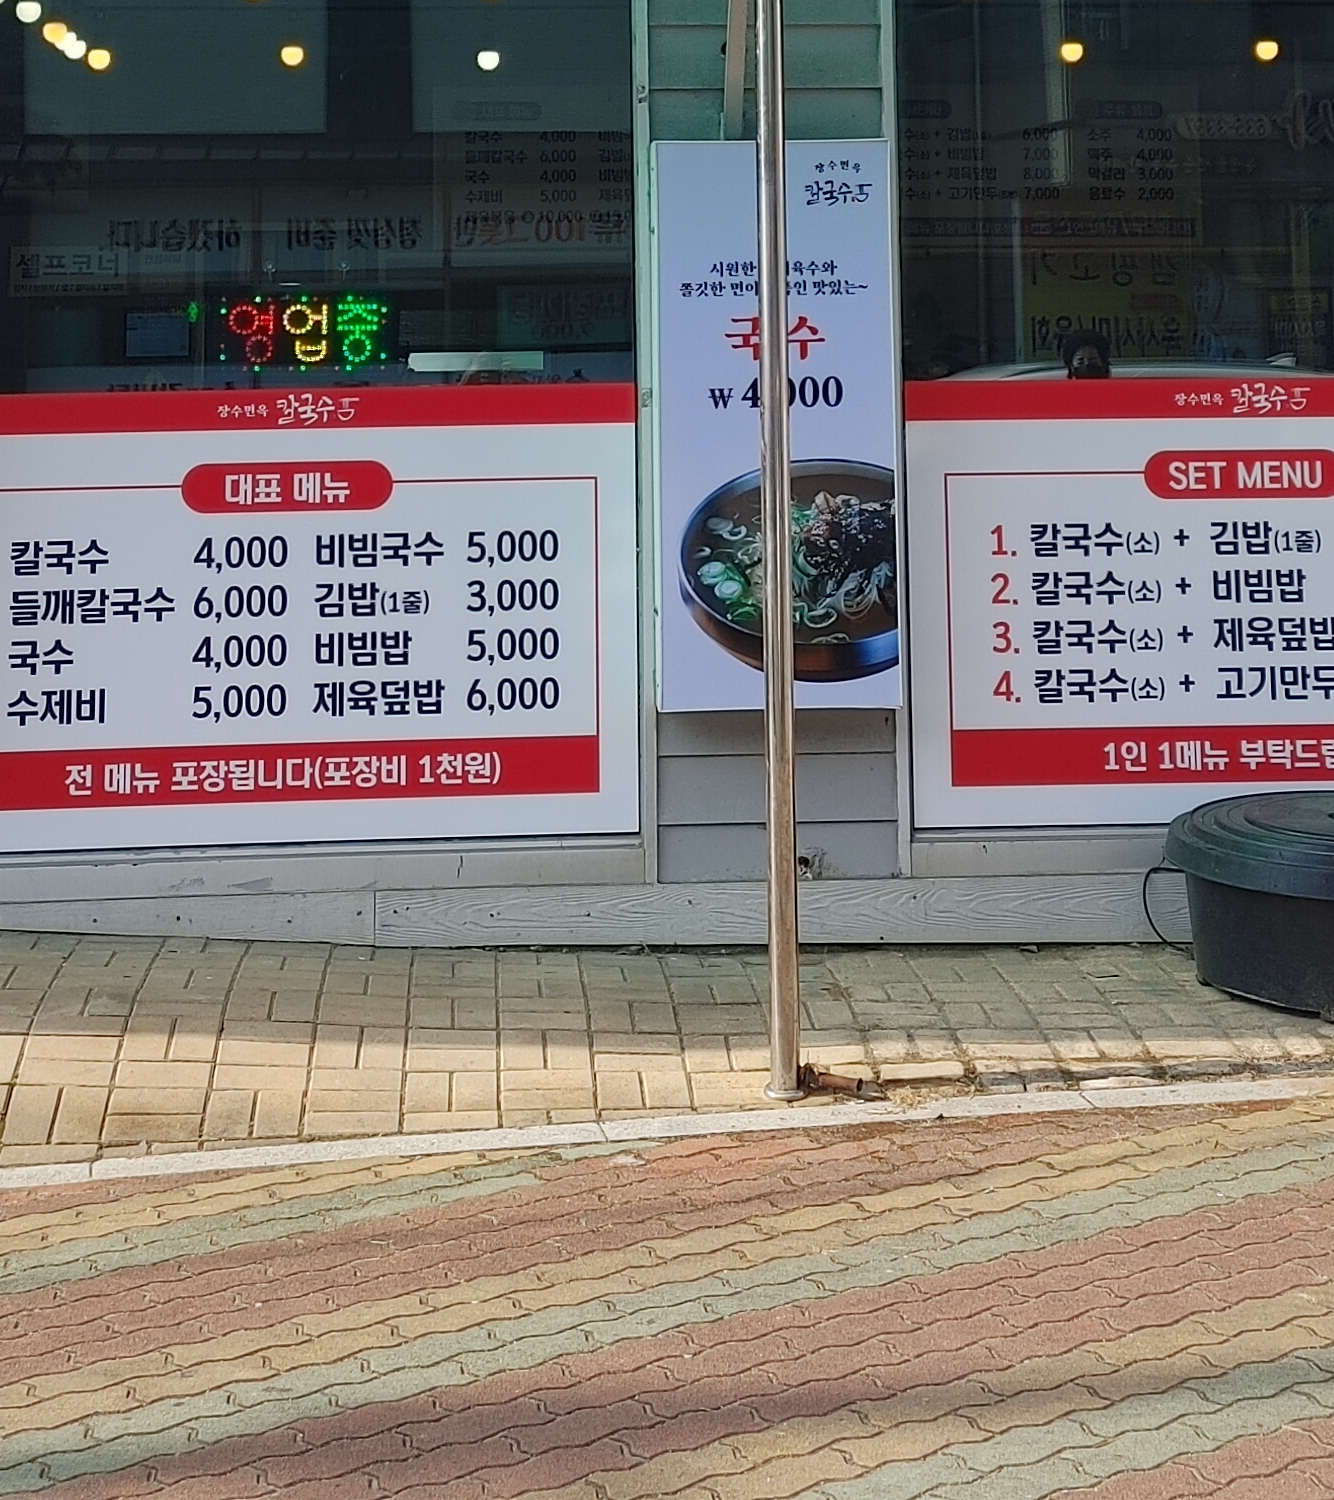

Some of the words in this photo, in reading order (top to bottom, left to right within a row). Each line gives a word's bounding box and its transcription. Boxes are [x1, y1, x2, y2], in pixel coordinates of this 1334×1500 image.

[804, 180, 852, 207] 칼국수
[710, 261, 757, 278] 시원한
[227, 300, 378, 363] 영업중
[724, 316, 826, 361] 국수
[276, 394, 335, 425] 칼국수
[741, 376, 843, 408] 400
[1231, 383, 1288, 414] 칼국수
[224, 473, 283, 505] 대표
[292, 471, 352, 503] 메뉴
[1168, 461, 1227, 491] SET
[1237, 460, 1324, 489] MENU
[10, 539, 110, 576] 칼국수
[193, 535, 288, 574] 4,000
[316, 531, 445, 569] 비빔국수
[466, 529, 559, 568] 5,000
[990, 524, 1017, 557] 1.
[1029, 522, 1160, 558] 칼국수(소)
[1209, 520, 1321, 556] 김밥(1줄)
[9, 586, 176, 626] 들깨칼국수
[193, 584, 288, 624] 6,000
[314, 581, 430, 618] 김밥(1줄)
[466, 578, 559, 617] 3,000
[990, 572, 1019, 606] 2.
[1031, 570, 1162, 606] 칼국수(소)
[1212, 568, 1307, 604] 비빔밥
[8, 639, 74, 676] 국수
[191, 633, 287, 674] 4,000
[315, 630, 413, 667] 비빔밥
[466, 627, 560, 666] 5,000
[992, 621, 1020, 655] 3.
[1032, 619, 1164, 655] 칼국수(소)
[6, 688, 106, 727] 수제비
[192, 683, 287, 724] 5,000
[312, 679, 446, 717] 제육덮밥
[466, 676, 560, 716] 6,000
[992, 670, 1021, 703] 4.
[1033, 667, 1165, 704] 칼국수(소)
[64, 764, 94, 797] 전
[104, 763, 160, 794] 메뉴
[418, 751, 501, 785] 1천원)
[1103, 741, 1148, 773] 1인
[1158, 740, 1230, 771] 1메뉴
